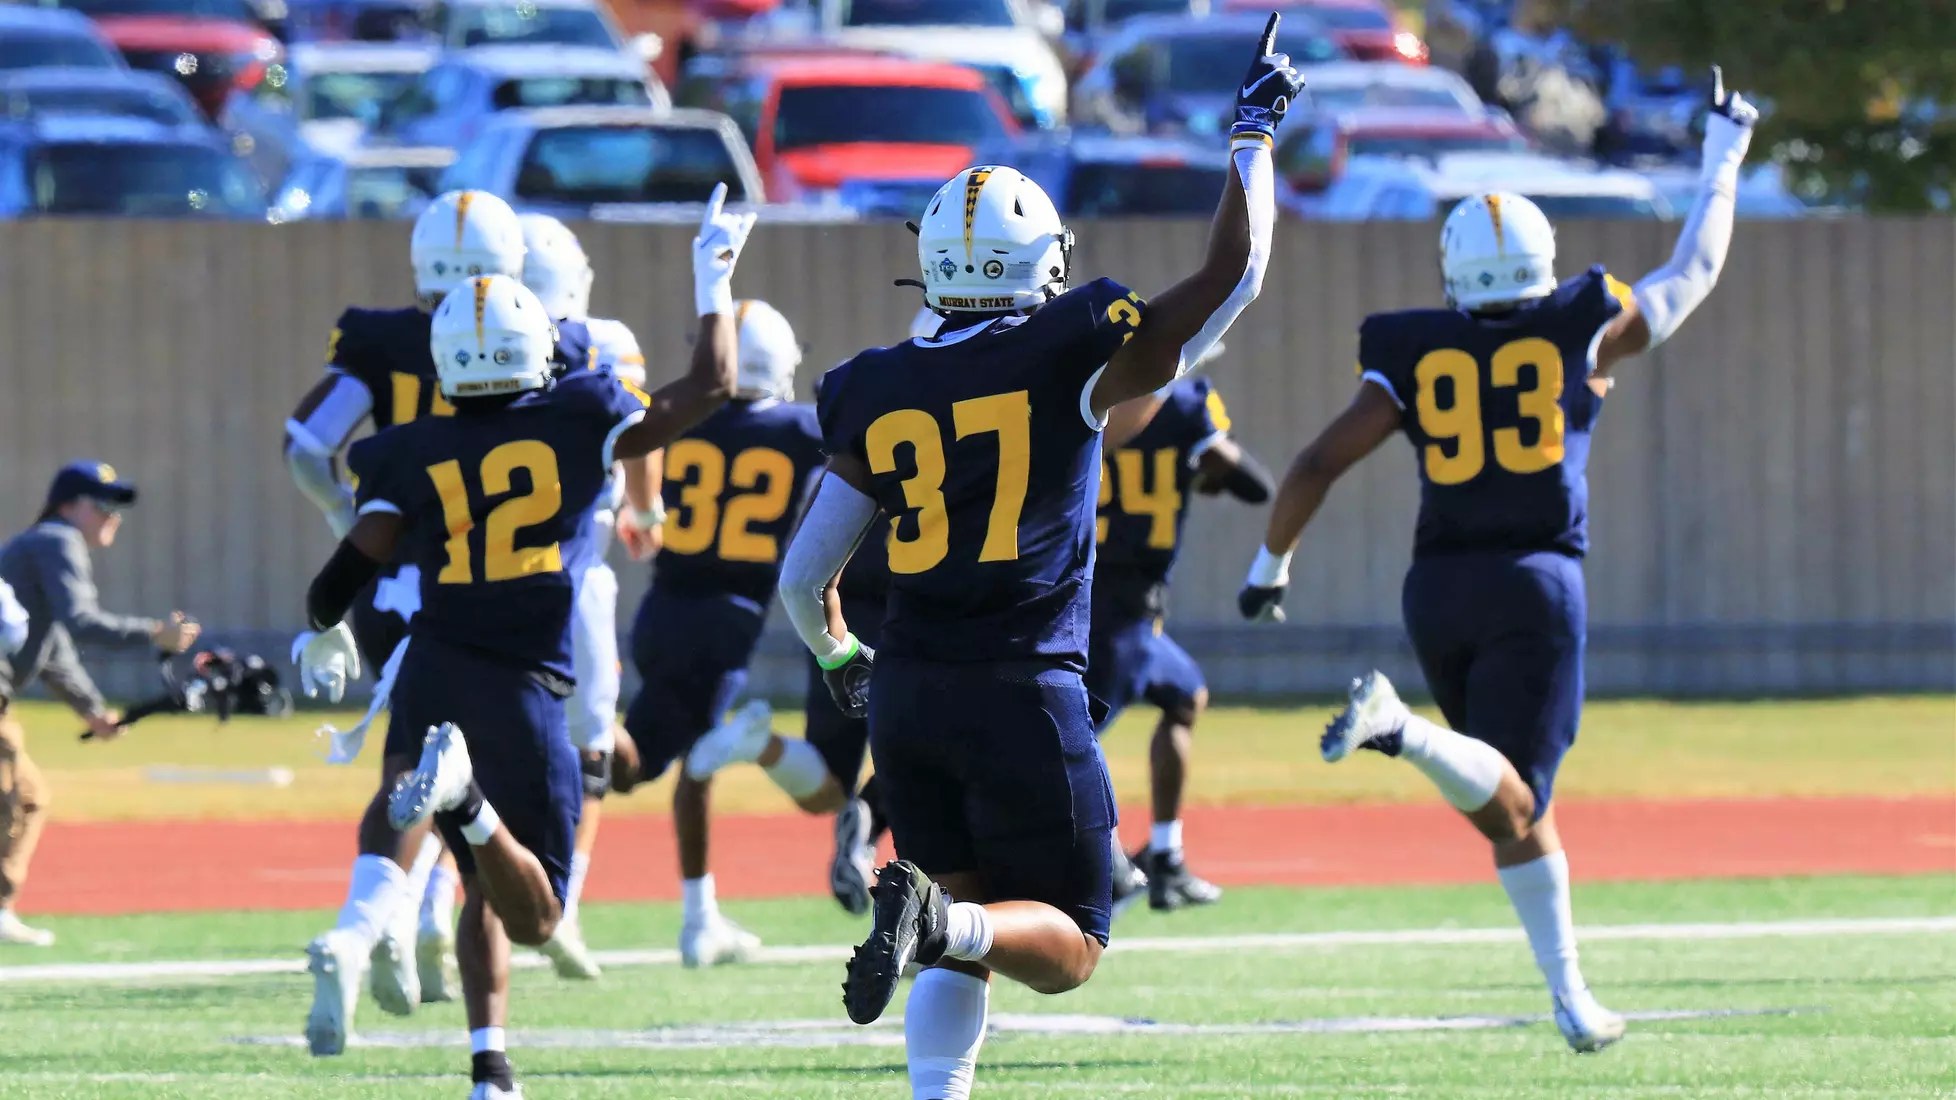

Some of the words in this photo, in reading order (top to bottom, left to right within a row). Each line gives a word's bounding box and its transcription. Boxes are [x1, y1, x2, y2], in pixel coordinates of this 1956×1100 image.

[939, 296, 977, 308] MURRAY
[979, 297, 1014, 308] STATE
[865, 390, 1030, 574] 37
[1415, 337, 1565, 485] 93
[426, 440, 563, 584] 12
[661, 438, 794, 562] 32
